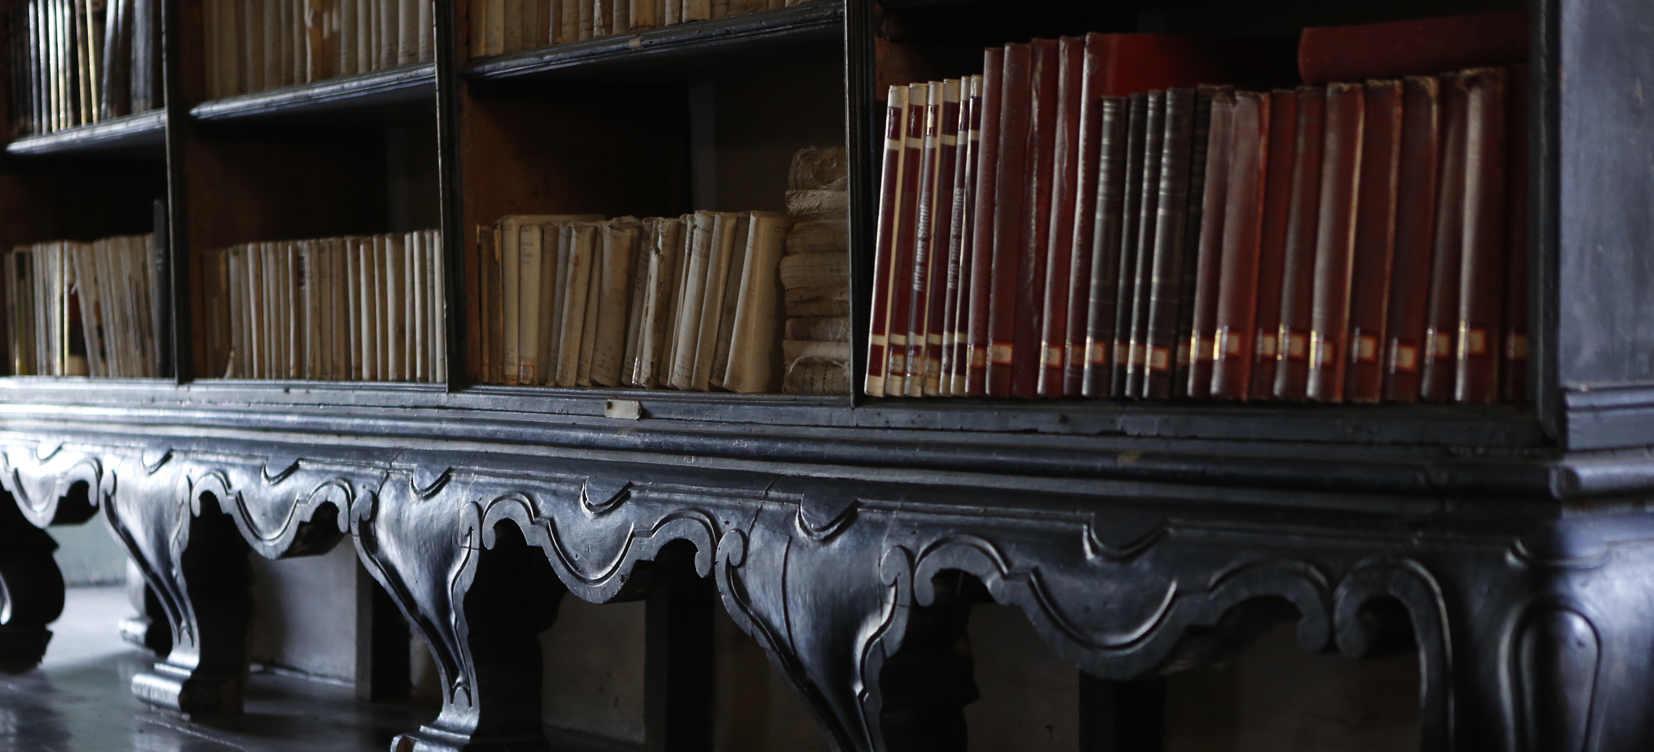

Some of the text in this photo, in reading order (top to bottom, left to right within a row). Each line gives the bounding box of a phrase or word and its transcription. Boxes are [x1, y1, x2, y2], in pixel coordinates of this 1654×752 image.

[916, 240, 928, 263] nos
[913, 264, 926, 292] Arte
[947, 263, 960, 290] Arte
